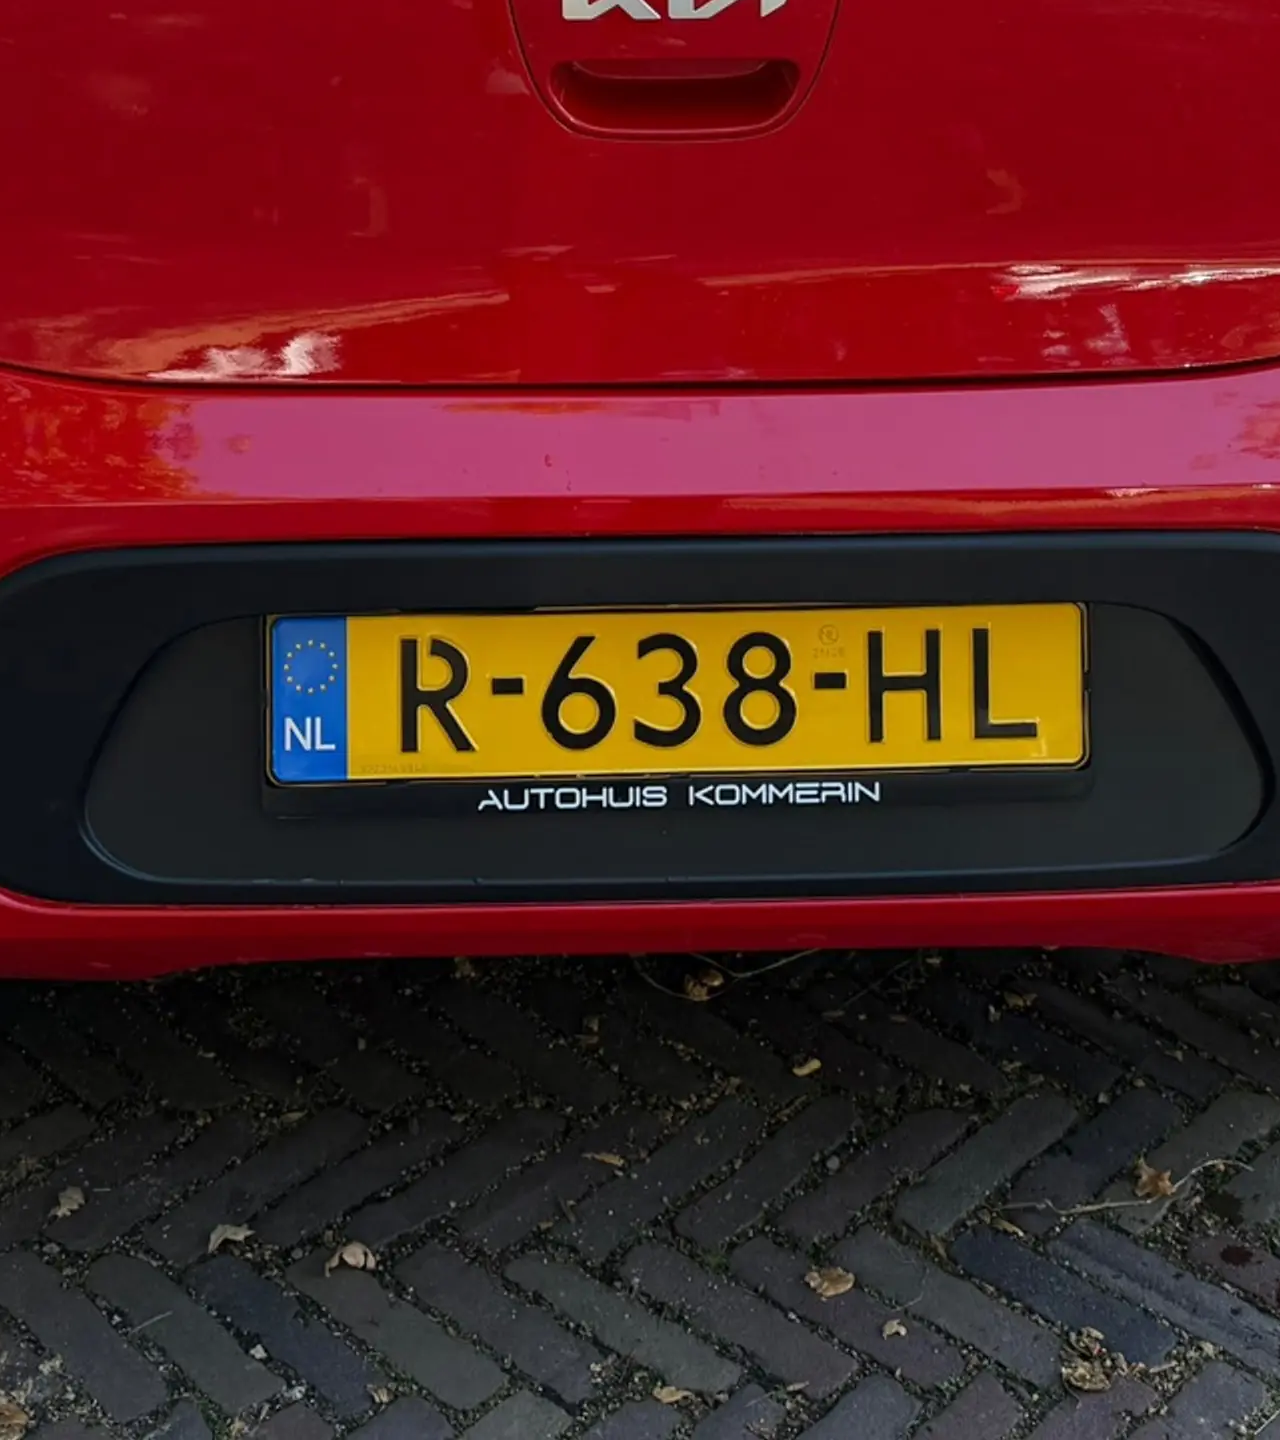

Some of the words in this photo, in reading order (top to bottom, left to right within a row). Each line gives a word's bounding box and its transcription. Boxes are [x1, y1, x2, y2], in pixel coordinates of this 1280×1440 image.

[399, 626, 1039, 754] R-638-HL
[284, 716, 336, 751] NL
[477, 787, 668, 812] AUTOHUIS
[688, 781, 881, 807] KOMMERIN
